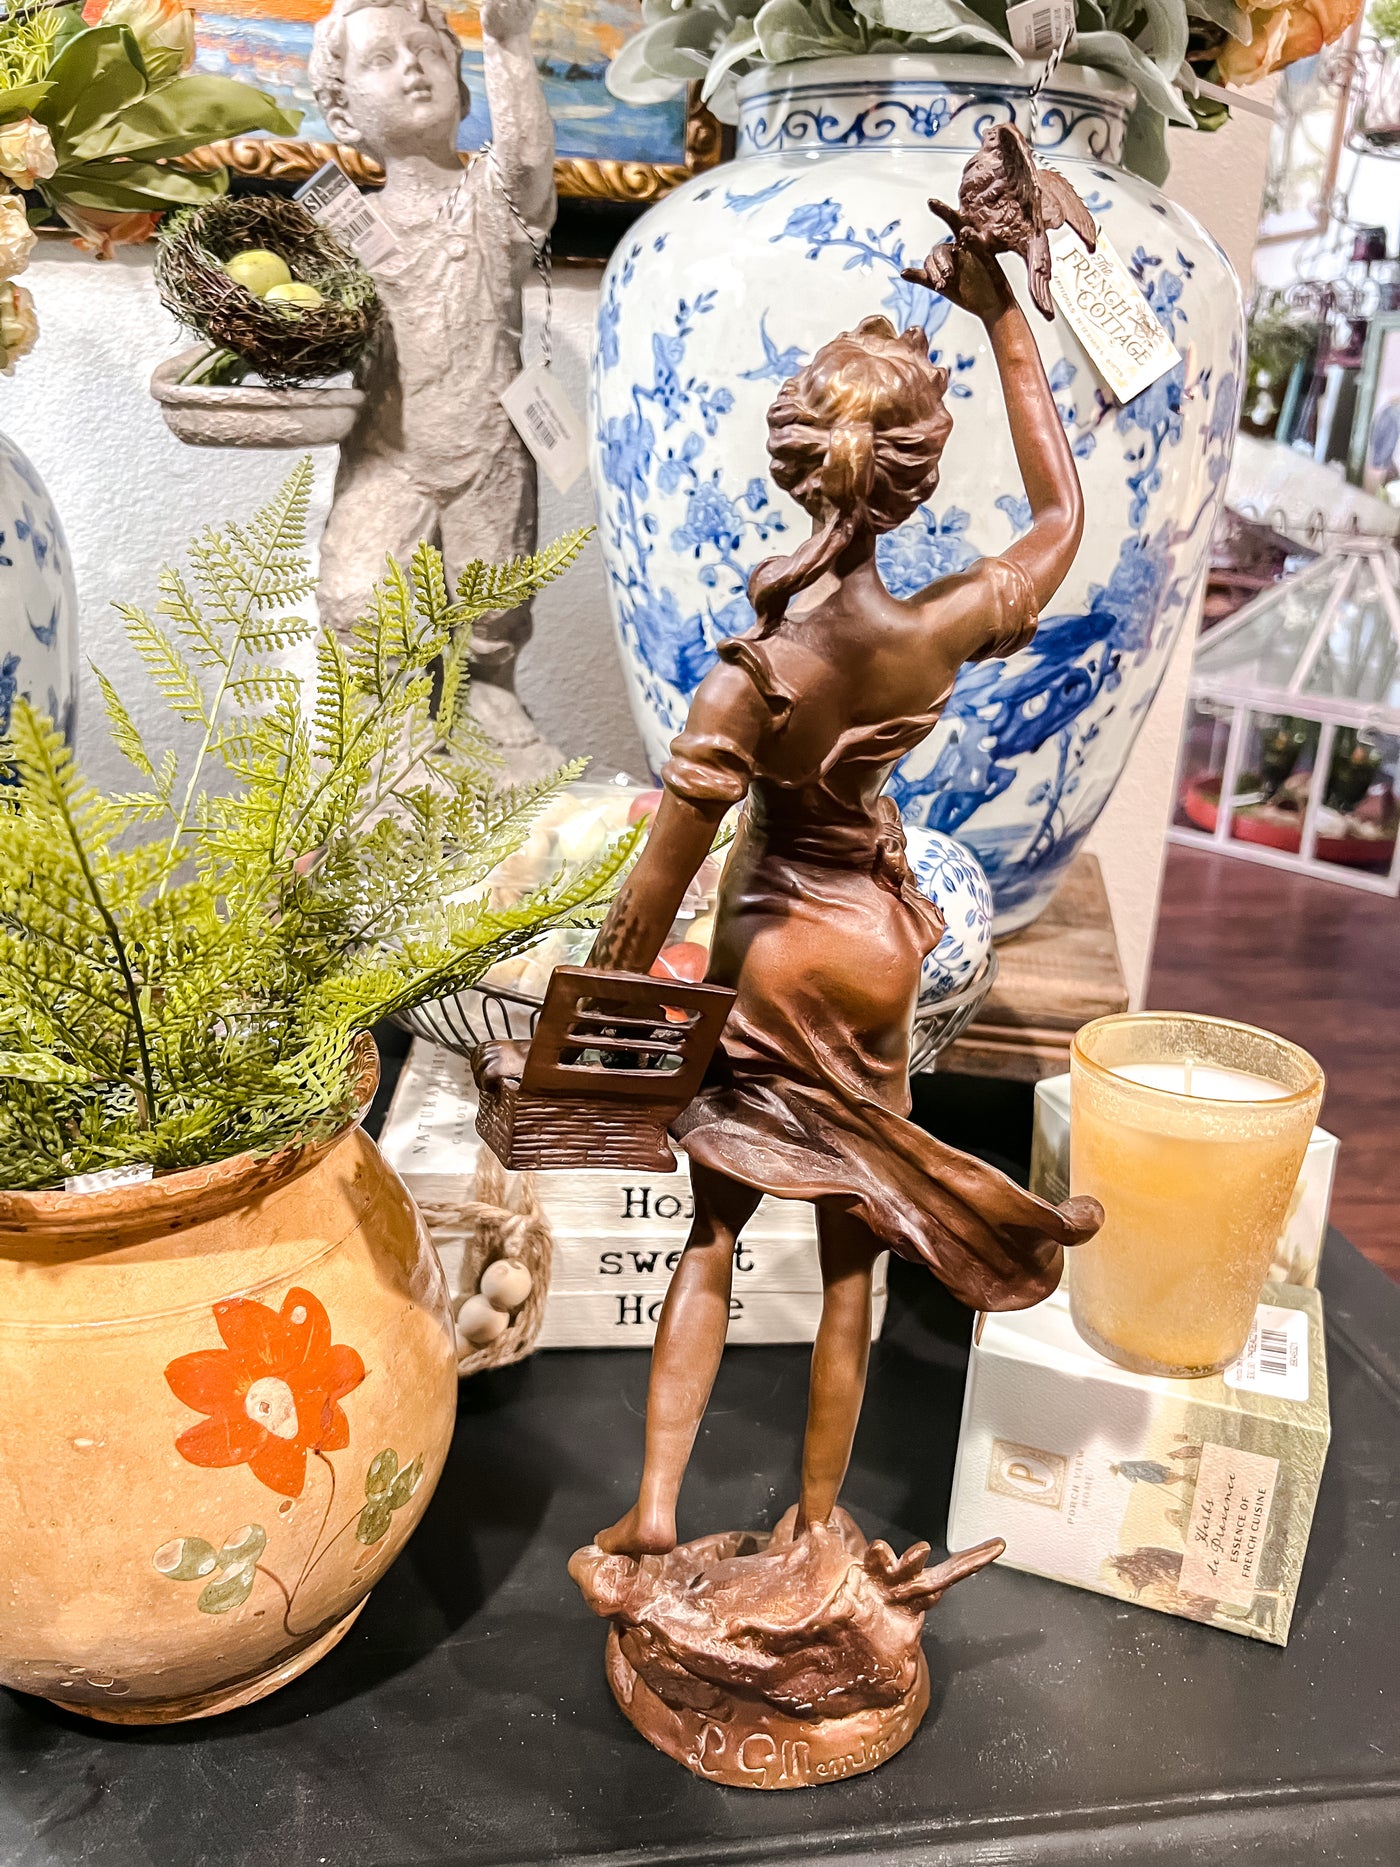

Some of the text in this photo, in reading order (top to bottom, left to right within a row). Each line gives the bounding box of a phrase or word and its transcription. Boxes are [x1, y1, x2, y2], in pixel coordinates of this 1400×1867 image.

[1056, 247, 1132, 317] FRENCH
[1091, 253, 1114, 277] The
[1077, 288, 1151, 366] COTTAGE
[412, 1082, 440, 1154] NATURAL
[600, 1241, 755, 1275] swet
[615, 1295, 744, 1326] Hoe
[1007, 1462, 1048, 1488] P
[1067, 1449, 1085, 1525] PORCH VIEW
[1081, 1476, 1094, 1508] HOME
[1195, 1498, 1214, 1547] Herbs
[1207, 1472, 1236, 1576] de Provence
[1230, 1496, 1250, 1563] ESSENCE OF
[1242, 1488, 1267, 1578] FRENCH CUISINE
